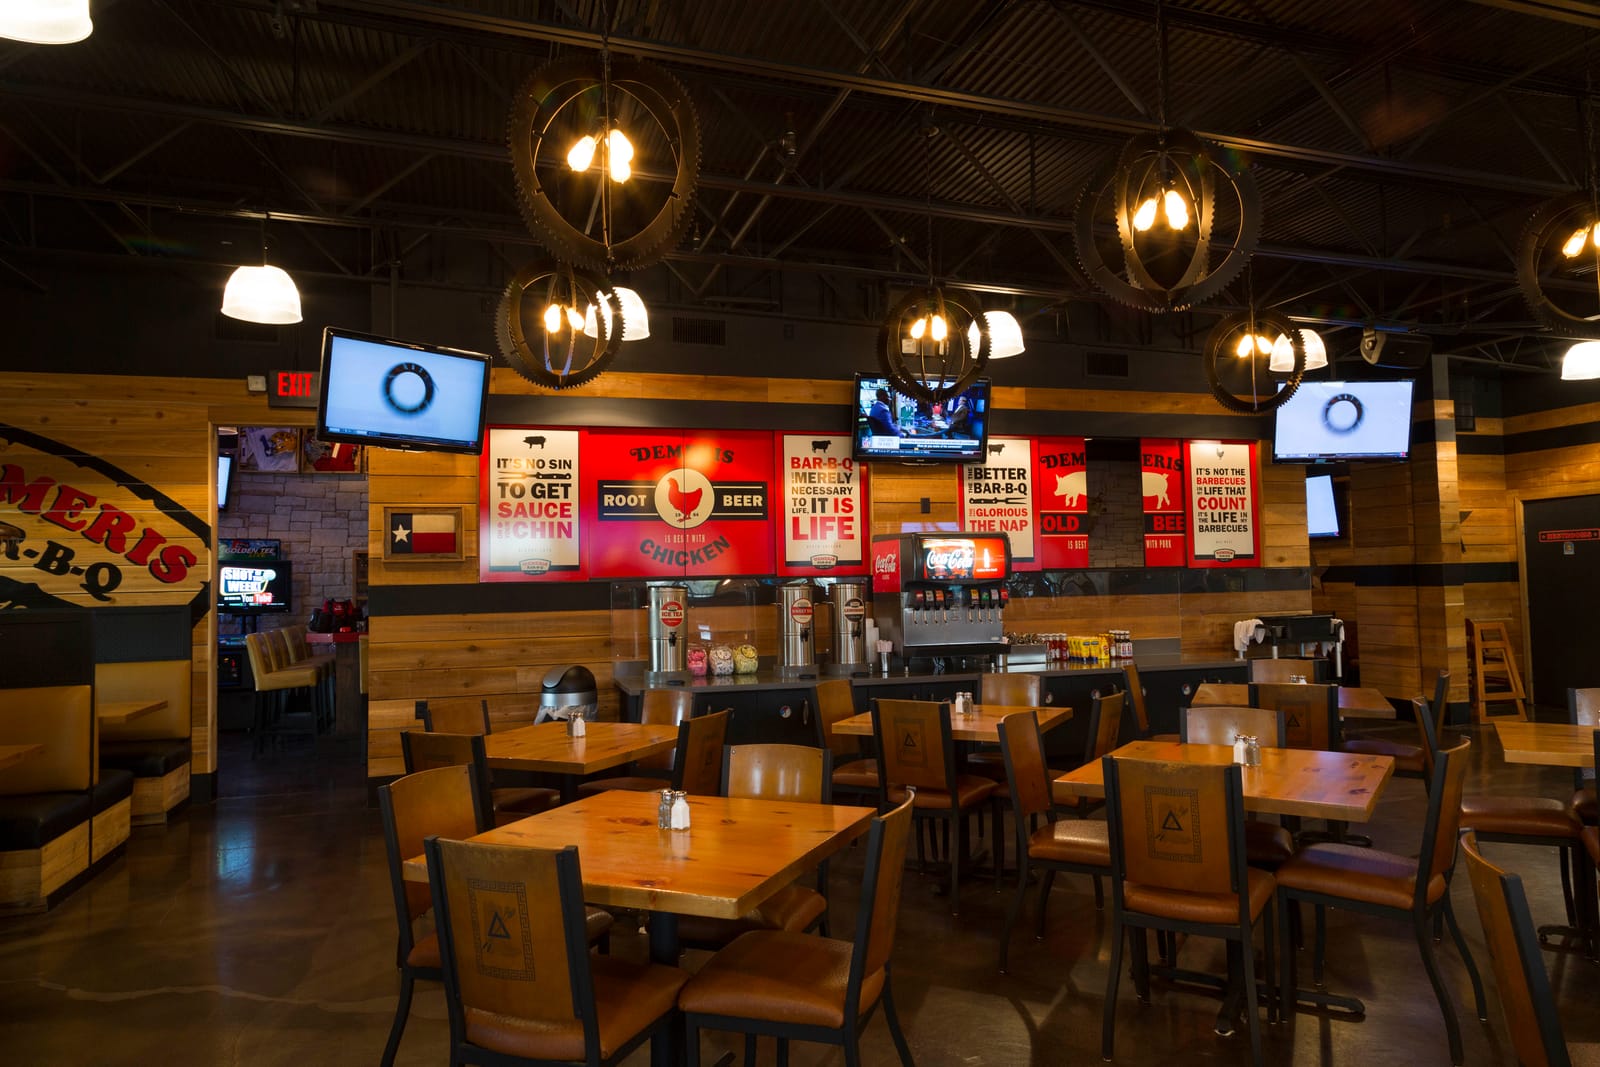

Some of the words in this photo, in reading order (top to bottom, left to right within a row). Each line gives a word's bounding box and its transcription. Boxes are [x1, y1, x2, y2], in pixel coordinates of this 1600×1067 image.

[277, 372, 312, 398] EXIT
[630, 445, 734, 464] DEMIS
[497, 458, 522, 469] IT'S
[526, 458, 546, 470] NO
[548, 458, 572, 470] SIN
[790, 457, 853, 471] BAR-B-Q
[1142, 454, 1183, 471] ERIS
[974, 468, 1026, 480] BETTER
[497, 482, 526, 499] TO
[530, 482, 572, 499] GET
[792, 487, 853, 495] NECESSARY
[974, 483, 1028, 496] BAR-B-Q
[1204, 487, 1223, 495] LIFE
[1225, 487, 1246, 495] THAT
[604, 495, 647, 506] ROOT
[723, 495, 763, 507] BEER
[792, 498, 807, 506] TO
[812, 498, 828, 513] IT
[834, 498, 854, 513] IS
[1197, 497, 1247, 510] COUNT
[497, 502, 572, 518] SAUCE
[976, 508, 1028, 517] GLORIOUS
[1211, 512, 1237, 523] LIFE
[513, 521, 572, 539] CHIN
[792, 516, 855, 541] LIFE
[970, 520, 996, 532] THE
[1000, 520, 1028, 531] NAP
[1198, 525, 1248, 533] BARBECUES
[640, 535, 730, 567] CHICKEN
[875, 554, 896, 573] Coca-Cola
[926, 548, 974, 569] Coca-Cola
